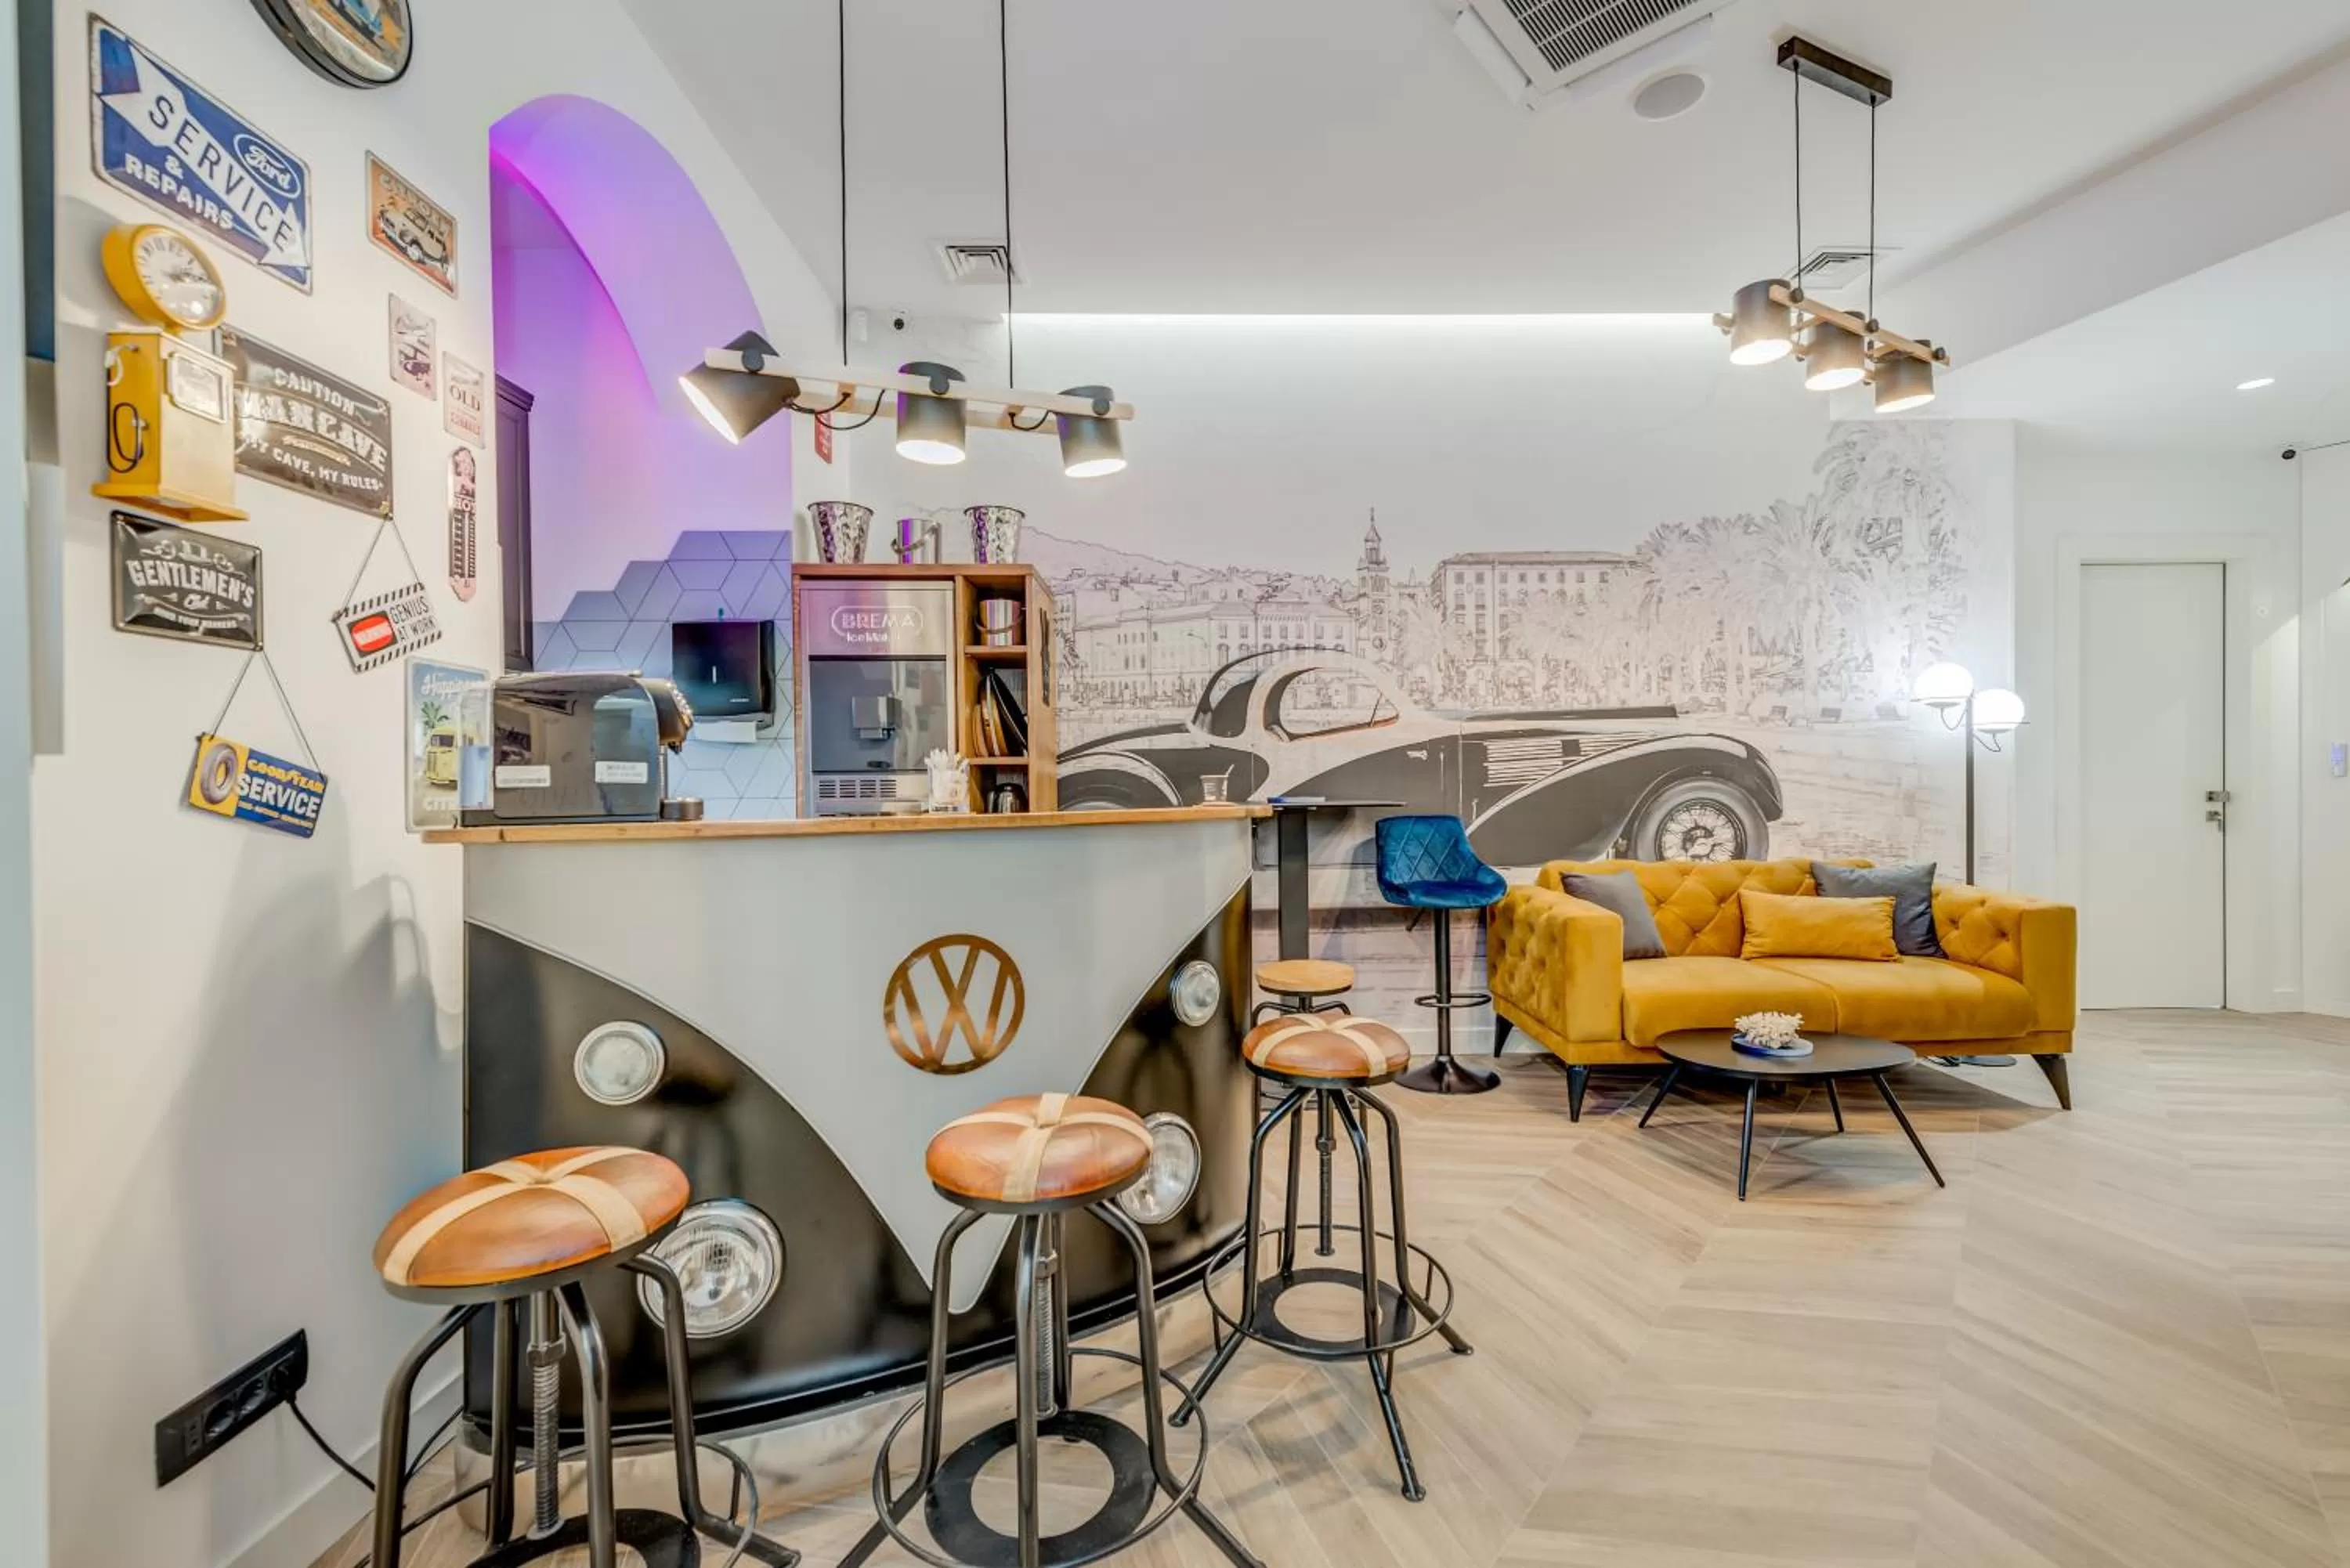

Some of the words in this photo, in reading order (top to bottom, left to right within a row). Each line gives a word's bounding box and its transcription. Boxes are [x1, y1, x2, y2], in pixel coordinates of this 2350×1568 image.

[148, 95, 292, 251] SERVICE
[164, 154, 183, 179] &
[244, 144, 291, 190] Ford
[125, 154, 234, 230] REPAIRS
[274, 367, 355, 416] CAUTION
[450, 384, 480, 412] OLD
[316, 411, 389, 472] CAVE
[272, 447, 315, 478] CAVE,
[318, 465, 339, 482] MY
[341, 471, 379, 491] RULES
[125, 560, 255, 609] GENTLEMEN'S
[389, 595, 429, 624] GENIUS
[842, 612, 916, 630] BREMA
[397, 625, 408, 641] AT
[237, 773, 322, 818] SERVICE
